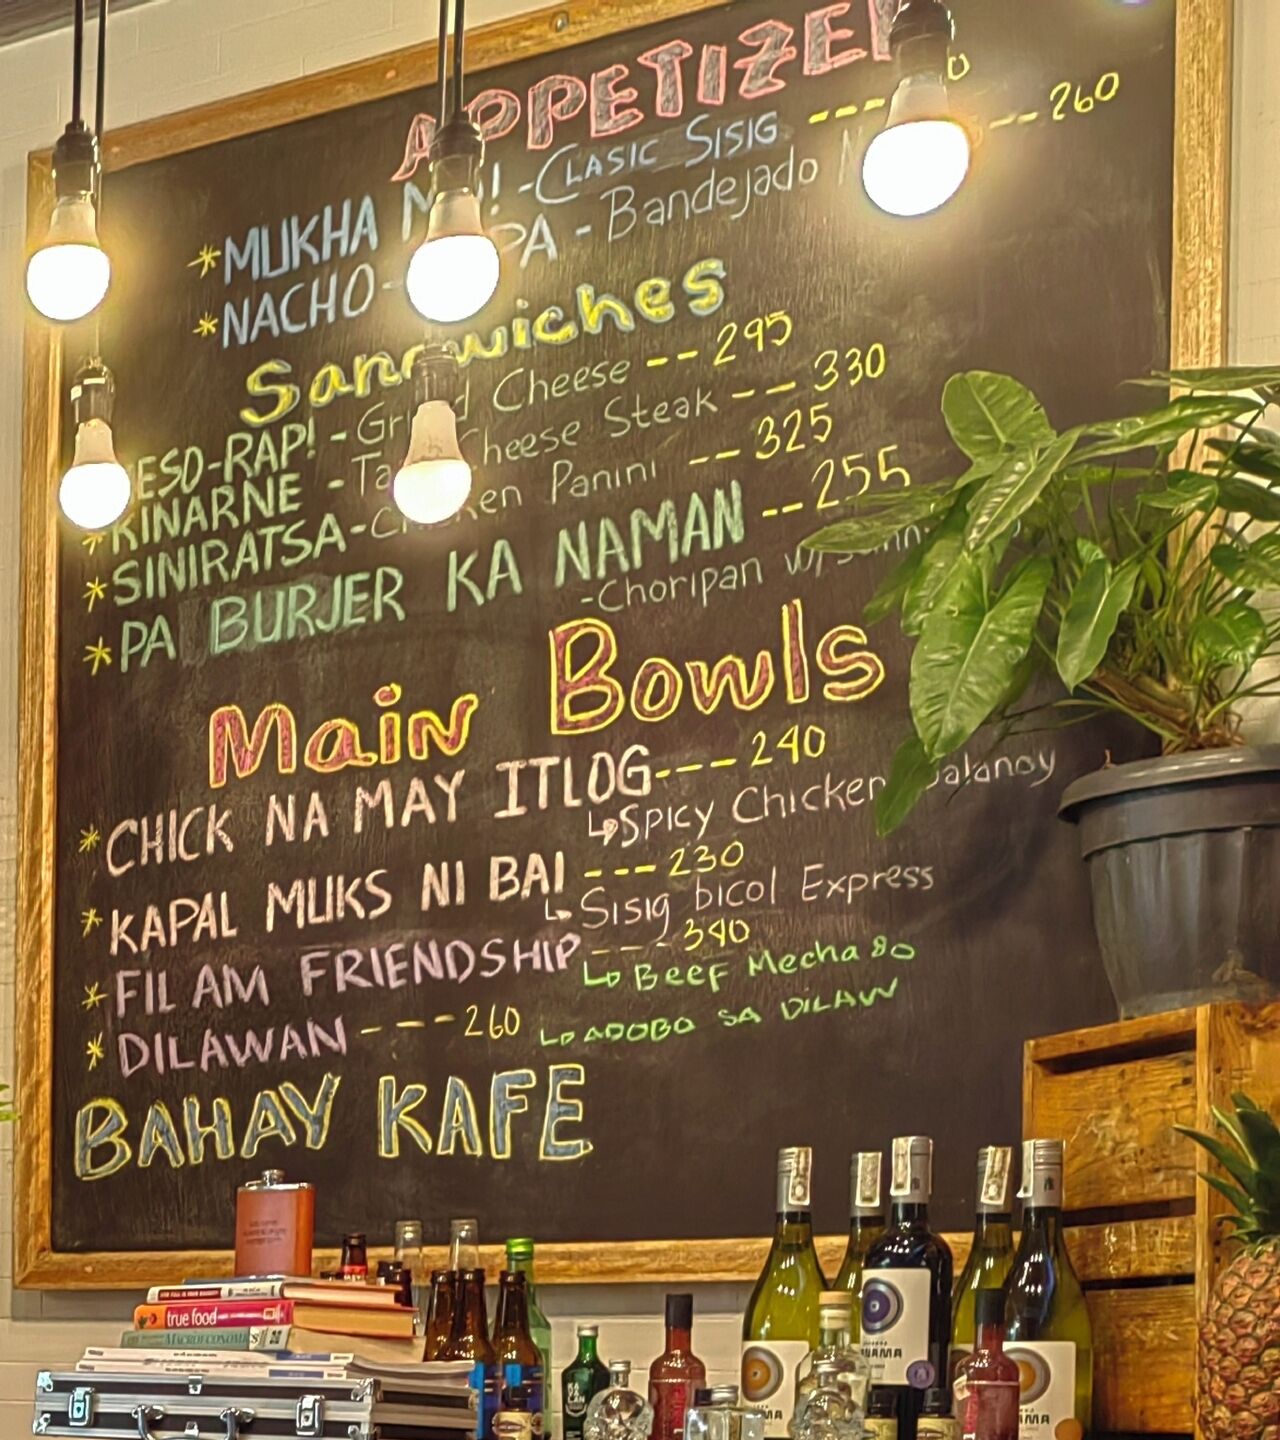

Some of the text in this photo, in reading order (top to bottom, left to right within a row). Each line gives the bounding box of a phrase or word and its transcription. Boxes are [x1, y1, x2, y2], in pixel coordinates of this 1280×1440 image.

[600, 158, 819, 243] Bandejado
[1049, 72, 1121, 121] 260
[223, 194, 379, 286] MUKHA
[493, 357, 632, 412] Cheese
[712, 310, 793, 367] 295
[605, 387, 719, 439] Steak
[814, 342, 886, 394] 330
[552, 460, 657, 505] Panini
[755, 402, 834, 460] 325
[120, 445, 911, 673] PA BURJER KA NAMAN 255
[209, 598, 886, 789] Main Bowls
[106, 724, 827, 879] CHICK NA MAY ITLOG 240
[110, 840, 744, 957] KAPAL MUKS NI BAI 230
[801, 861, 936, 906] Express
[115, 968, 177, 1019] FIL
[193, 962, 270, 1007] AM
[300, 932, 582, 997] FRIENDSHIP
[584, 1016, 696, 1043] ADOBO
[717, 1005, 762, 1028] SA
[117, 1005, 522, 1078] DILAWAN 260
[75, 1063, 594, 1182] BAHAY KAFE
[167, 1306, 217, 1327] true food
